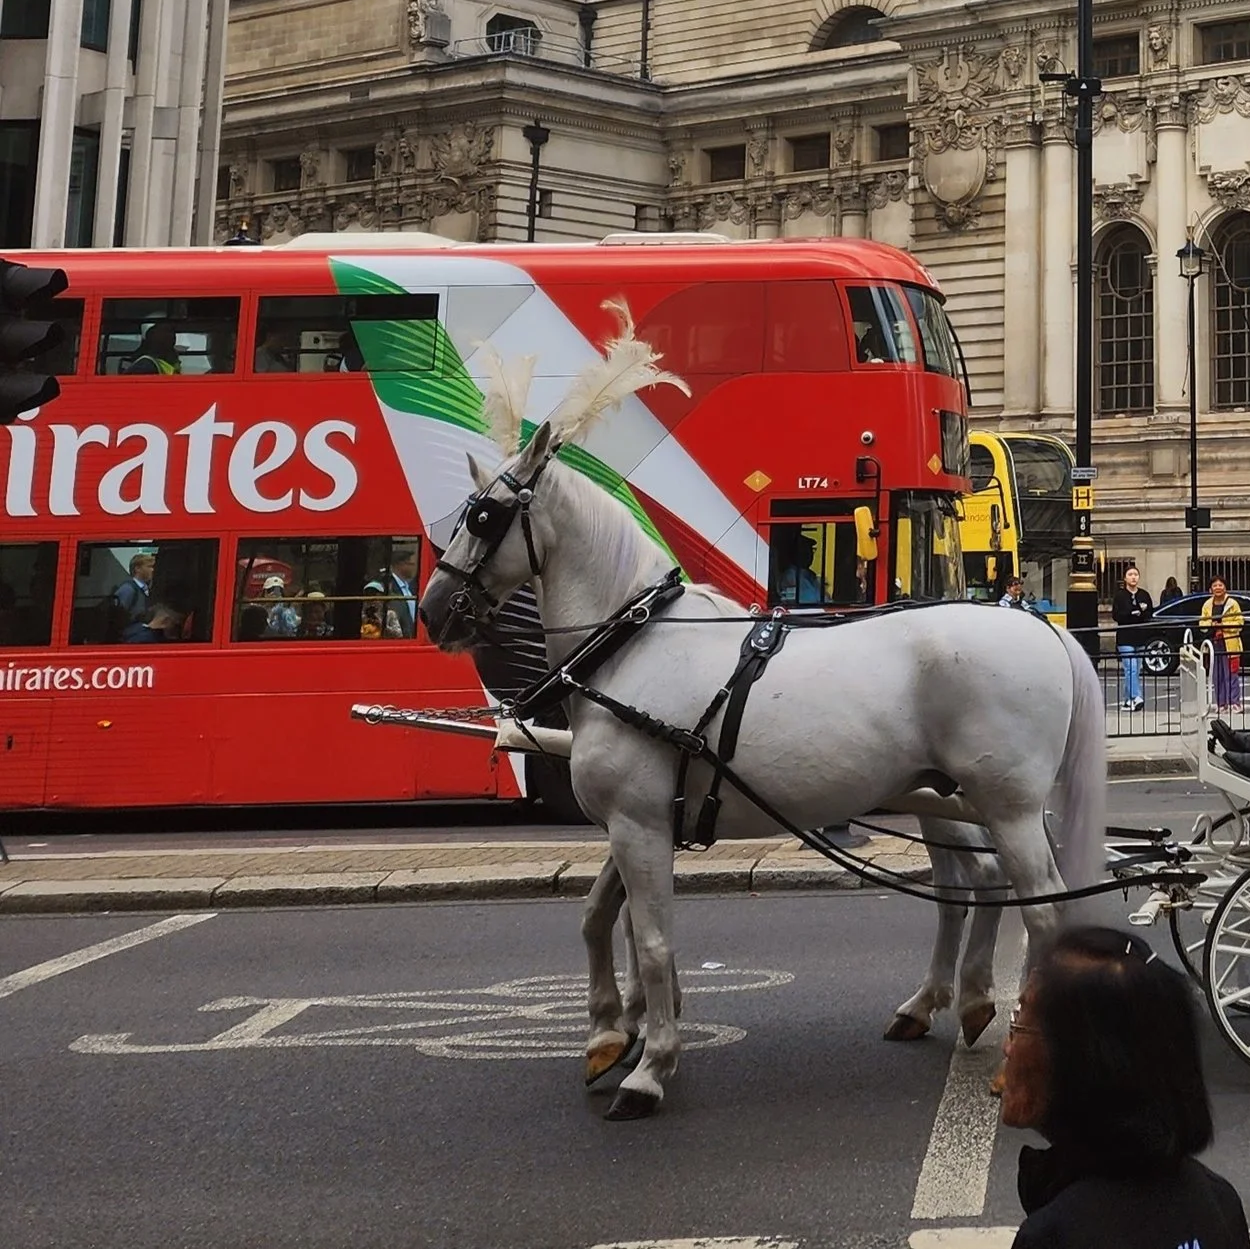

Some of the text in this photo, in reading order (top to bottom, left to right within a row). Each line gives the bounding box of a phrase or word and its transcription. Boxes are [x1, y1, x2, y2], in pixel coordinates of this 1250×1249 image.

[798, 477, 829, 489] LT74
[1075, 488, 1091, 507] H
[0, 662, 154, 691] irates.com
